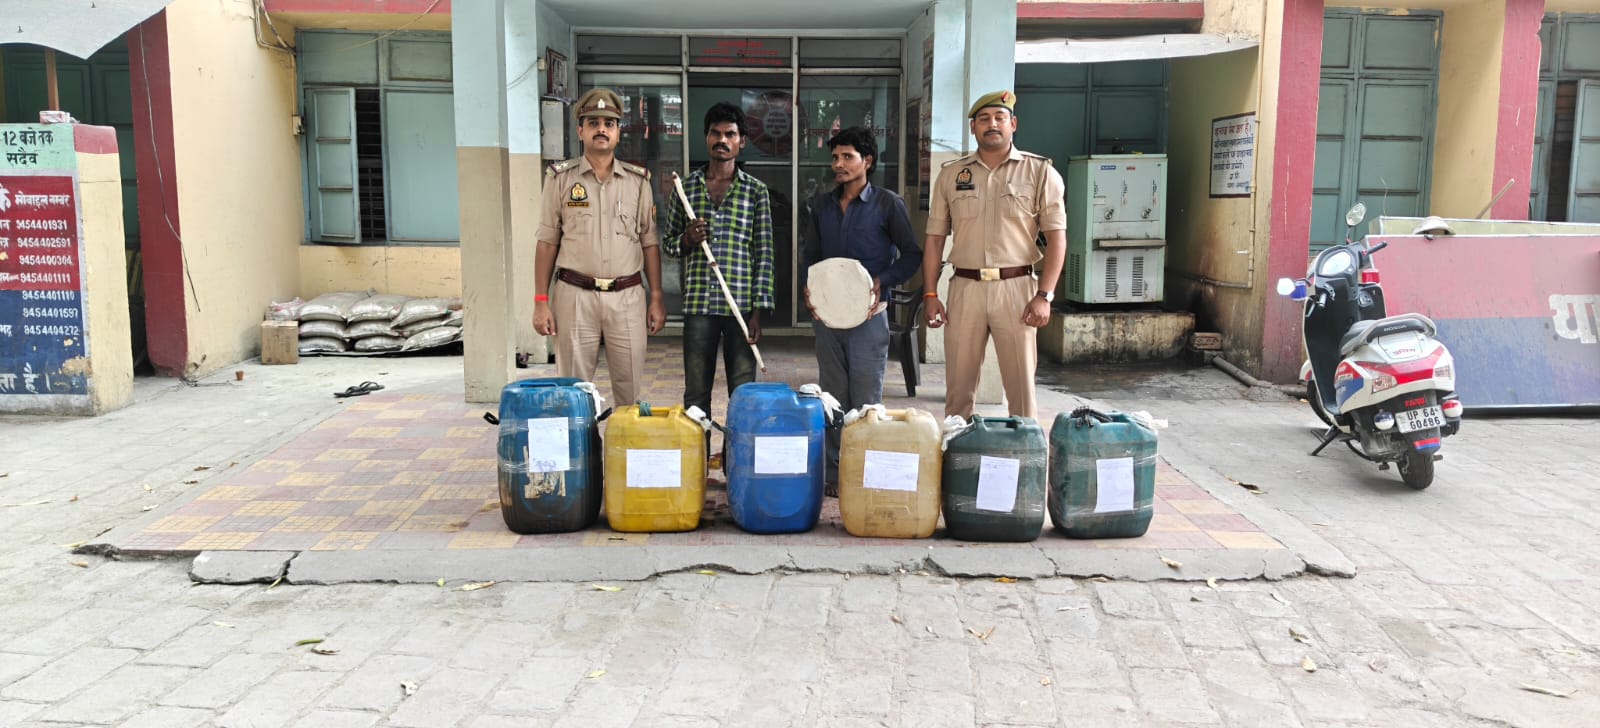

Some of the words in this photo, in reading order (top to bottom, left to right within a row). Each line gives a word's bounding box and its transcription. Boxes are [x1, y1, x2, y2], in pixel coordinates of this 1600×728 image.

[3, 131, 17, 146] 12
[38, 131, 53, 145] तक
[6, 146, 38, 164] सदैव
[15, 190, 48, 208] मोबाइल
[22, 290, 75, 300] 9454401110
[1407, 410, 1419, 421] UP
[1423, 407, 1435, 418] 64
